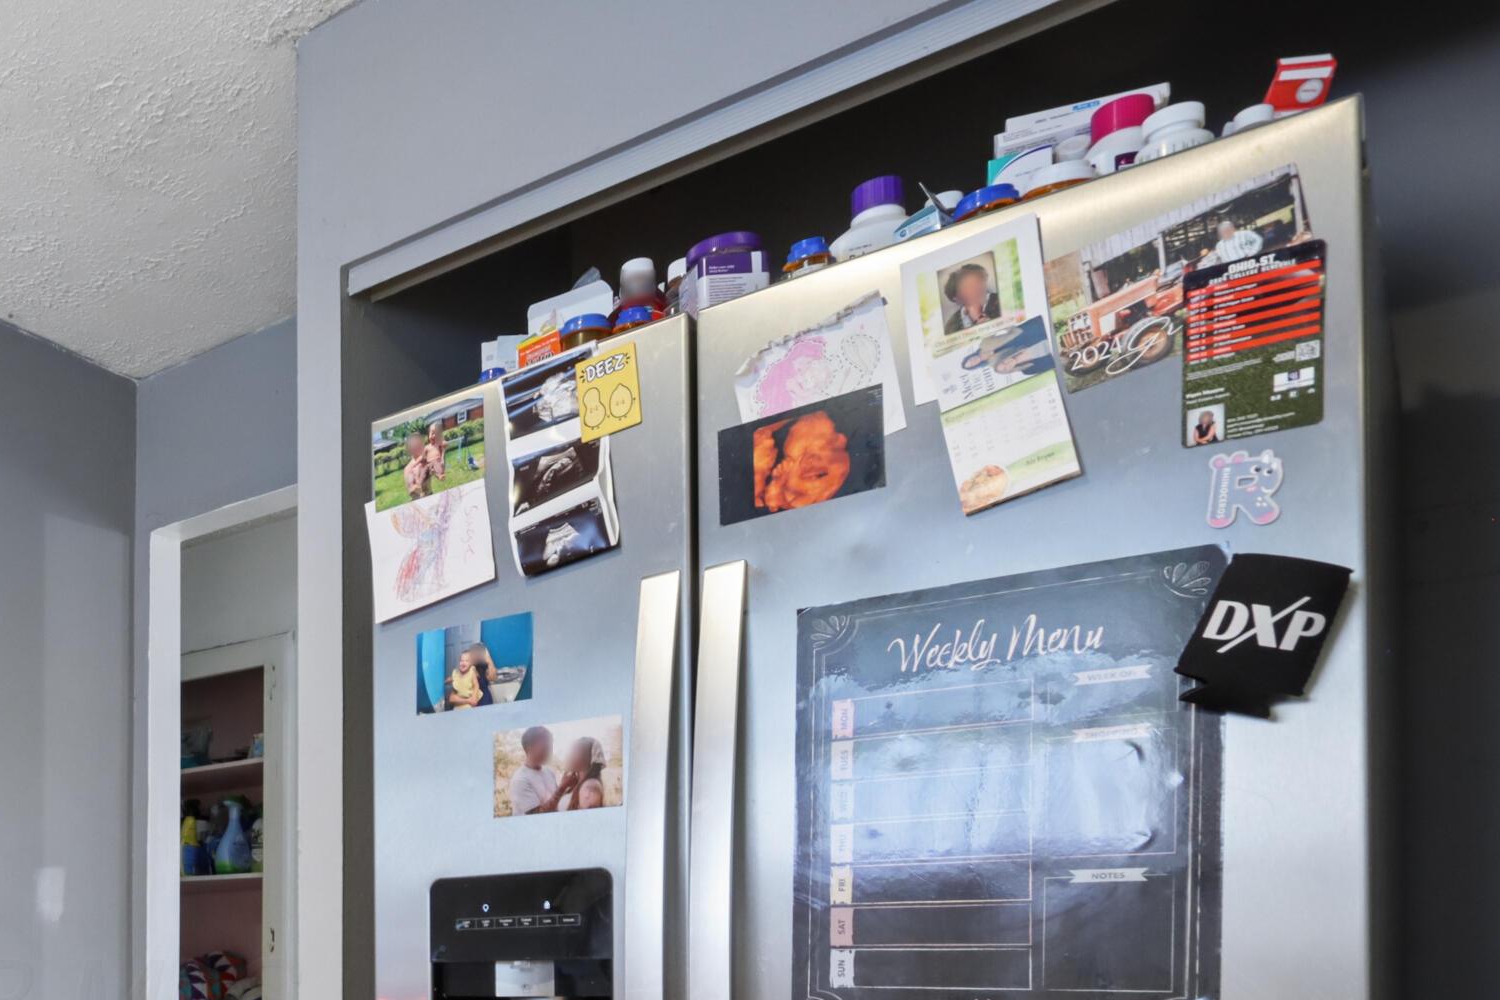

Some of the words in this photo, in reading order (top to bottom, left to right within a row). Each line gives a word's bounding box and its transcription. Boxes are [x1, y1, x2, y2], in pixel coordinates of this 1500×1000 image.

[1068, 335, 1122, 371] 2024
[585, 353, 625, 383] DEEZ
[1202, 596, 1326, 653] DXP
[887, 619, 1000, 672] Weekly
[1006, 614, 1104, 661] Menu
[839, 708, 848, 730] MON
[839, 750, 848, 771] TUES
[838, 879, 846, 892] FRI
[1091, 872, 1125, 880] NOTES
[838, 920, 846, 935] SAT
[837, 960, 846, 978] SUN
